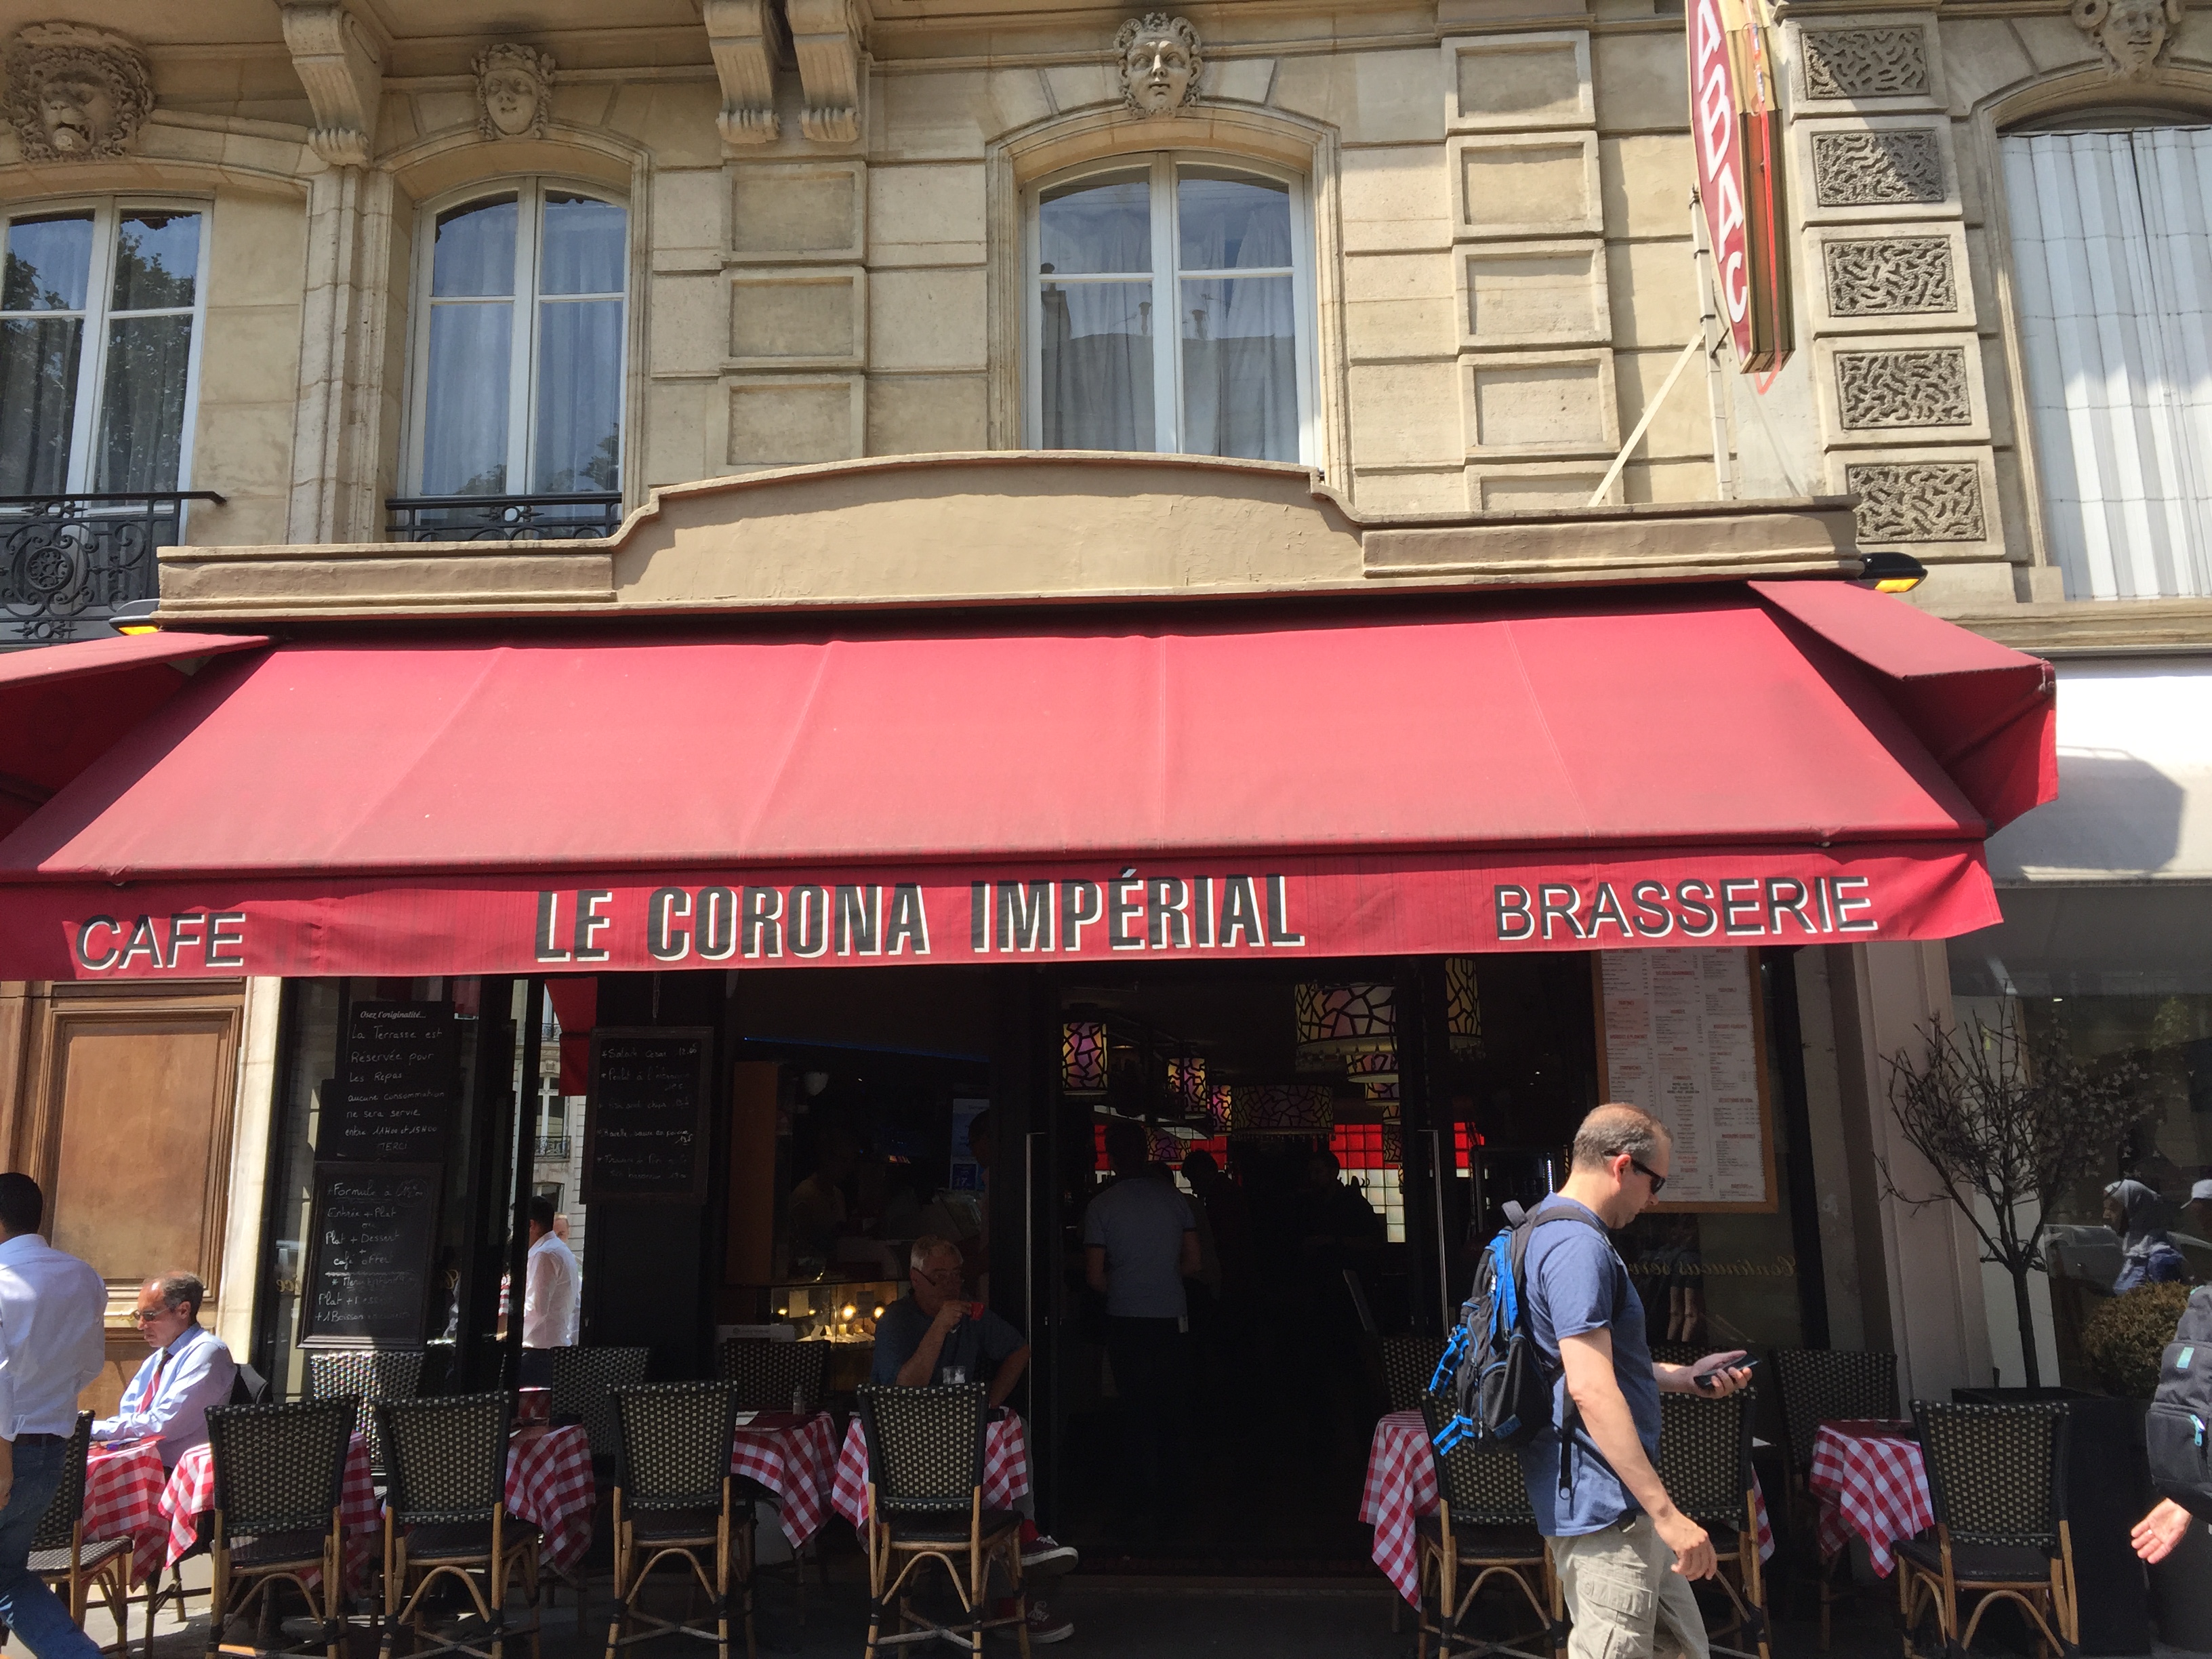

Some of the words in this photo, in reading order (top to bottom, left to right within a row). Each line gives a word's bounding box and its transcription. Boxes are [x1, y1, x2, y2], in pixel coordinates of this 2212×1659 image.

[1697, 0, 1748, 323] ABAC
[535, 890, 613, 962] LE
[647, 883, 931, 962] CORONA
[970, 865, 1305, 954] IMPÉRIAL
[1493, 876, 1879, 941] BRASSERIE
[75, 913, 247, 970] CAFE
[360, 1010, 376, 1019] Osez
[352, 1024, 365, 1039] La
[373, 1025, 417, 1040] Terrasse
[425, 1027, 443, 1038] est
[351, 1049, 402, 1063] Réservée
[409, 1052, 434, 1066] pour
[349, 1072, 364, 1082] Les
[374, 1071, 402, 1084] Repas
[348, 1094, 378, 1102] aucune
[390, 1109, 421, 1118] servie
[345, 1125, 366, 1136] entre
[401, 1125, 409, 1134] et
[333, 1179, 375, 1196] Formule
[375, 1206, 397, 1218] Plat
[325, 1229, 346, 1245] Plat
[361, 1229, 400, 1244] Dessert
[318, 1290, 343, 1307] Plat
